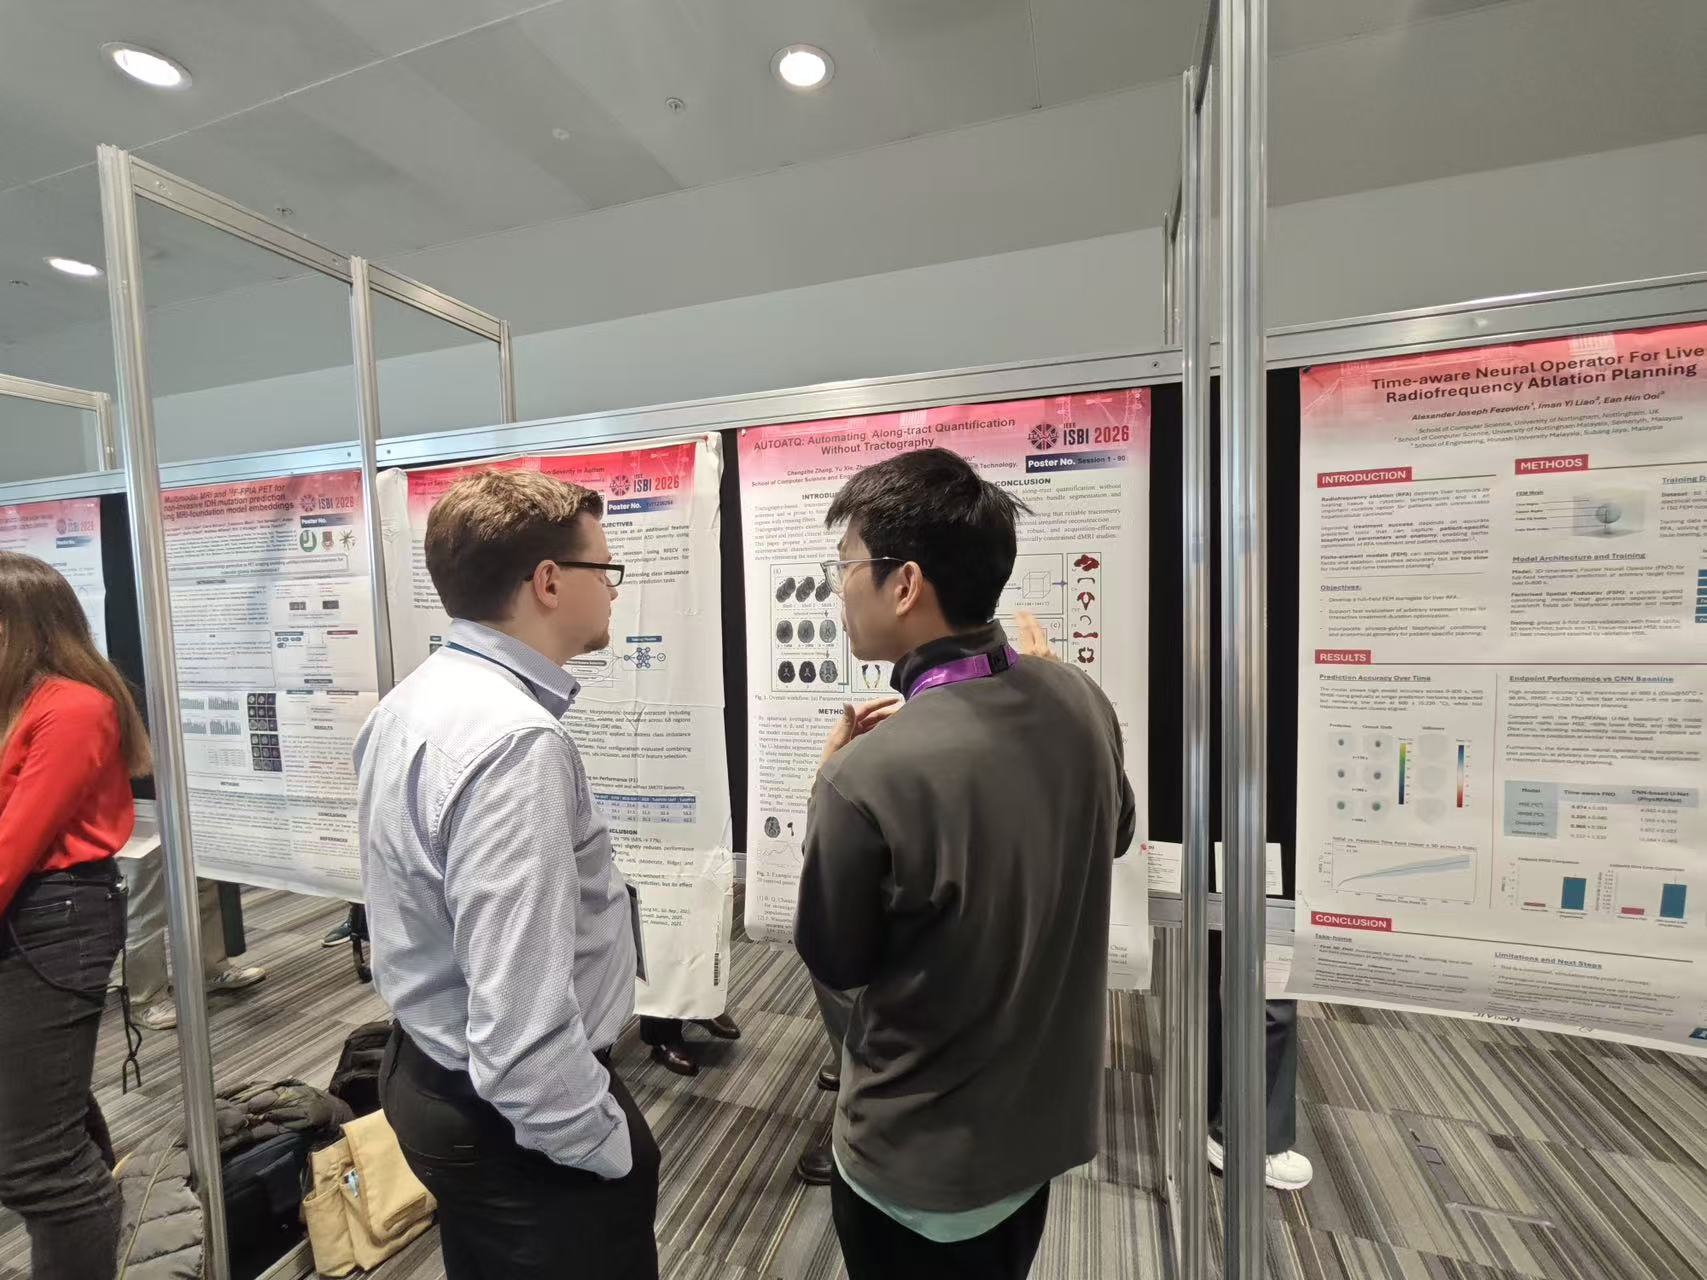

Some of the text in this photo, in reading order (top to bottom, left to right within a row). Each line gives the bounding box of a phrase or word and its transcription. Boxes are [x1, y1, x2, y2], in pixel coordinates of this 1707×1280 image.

[1372, 347, 1704, 389] Time-aware Neural Operator For Live
[1386, 363, 1697, 403] Radiofrequency Ablation Planning
[1412, 411, 1456, 420] Alexander
[1538, 401, 1561, 409] Iman
[1604, 396, 1621, 404] Ean
[754, 419, 1015, 450] AUTOATQ: Automating Along-tract Quantification
[1064, 425, 1129, 445] ISBI 2026
[821, 437, 934, 455] Without Tractography
[1028, 460, 1058, 468] Poster
[1521, 459, 1583, 470] METHODS
[634, 475, 679, 492] ISBI 2026
[996, 478, 1051, 487] CONCLUSION
[1322, 471, 1406, 484] INTRODUCTION
[218, 497, 247, 506] mutation
[250, 494, 285, 503] prediction
[802, 492, 836, 500] INTRODU
[226, 505, 247, 514] model
[249, 501, 294, 511] embeddings
[319, 498, 333, 509] ISBI
[1320, 654, 1366, 662] RESULTS
[1316, 914, 1386, 928] CONCLUSION
